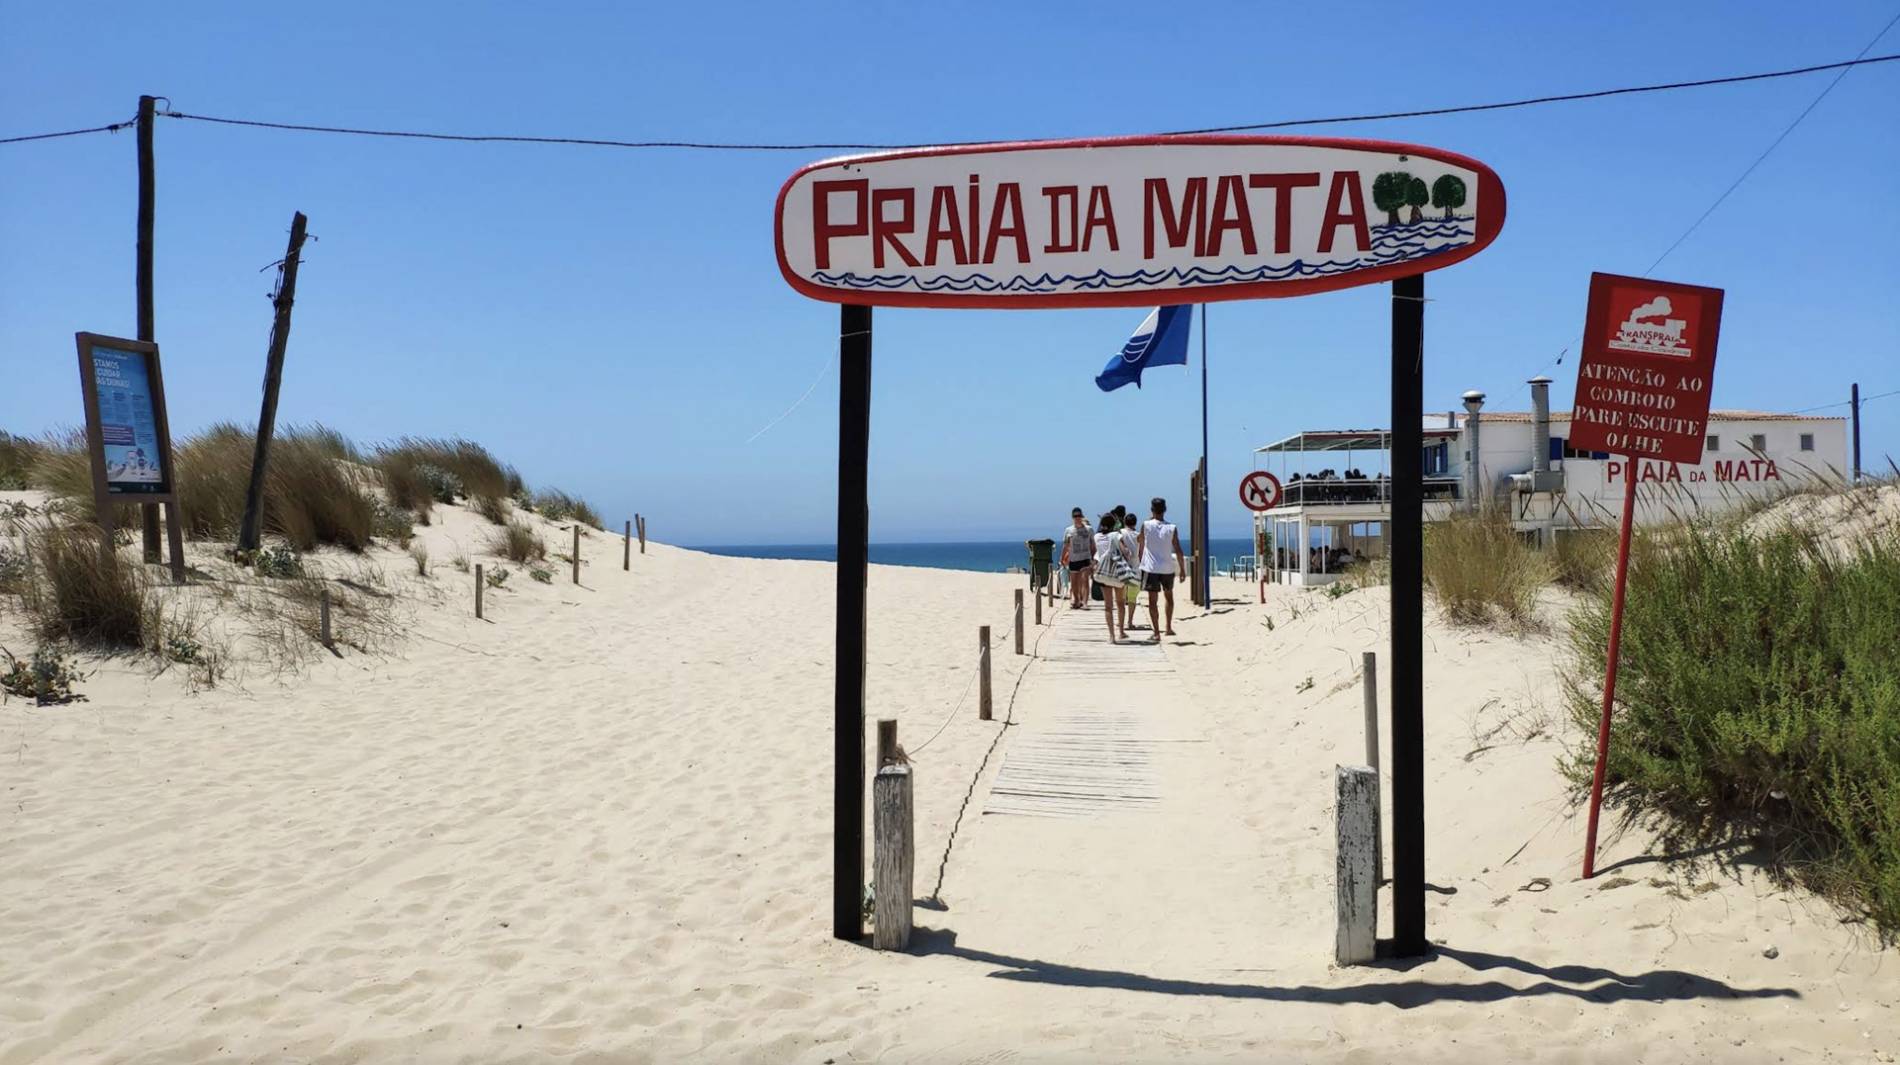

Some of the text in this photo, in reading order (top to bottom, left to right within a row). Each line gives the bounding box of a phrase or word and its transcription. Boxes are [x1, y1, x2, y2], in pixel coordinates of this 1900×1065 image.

[813, 170, 1373, 269] PRAIA DA MATA
[1581, 363, 1703, 392] ATENÇÃO AO
[1590, 385, 1676, 410] COMBOIO
[1574, 405, 1700, 437] PARE ESCUTE
[1606, 432, 1664, 454] OLHE
[1689, 471, 1707, 482] DA
[1715, 460, 1780, 482] MATA
